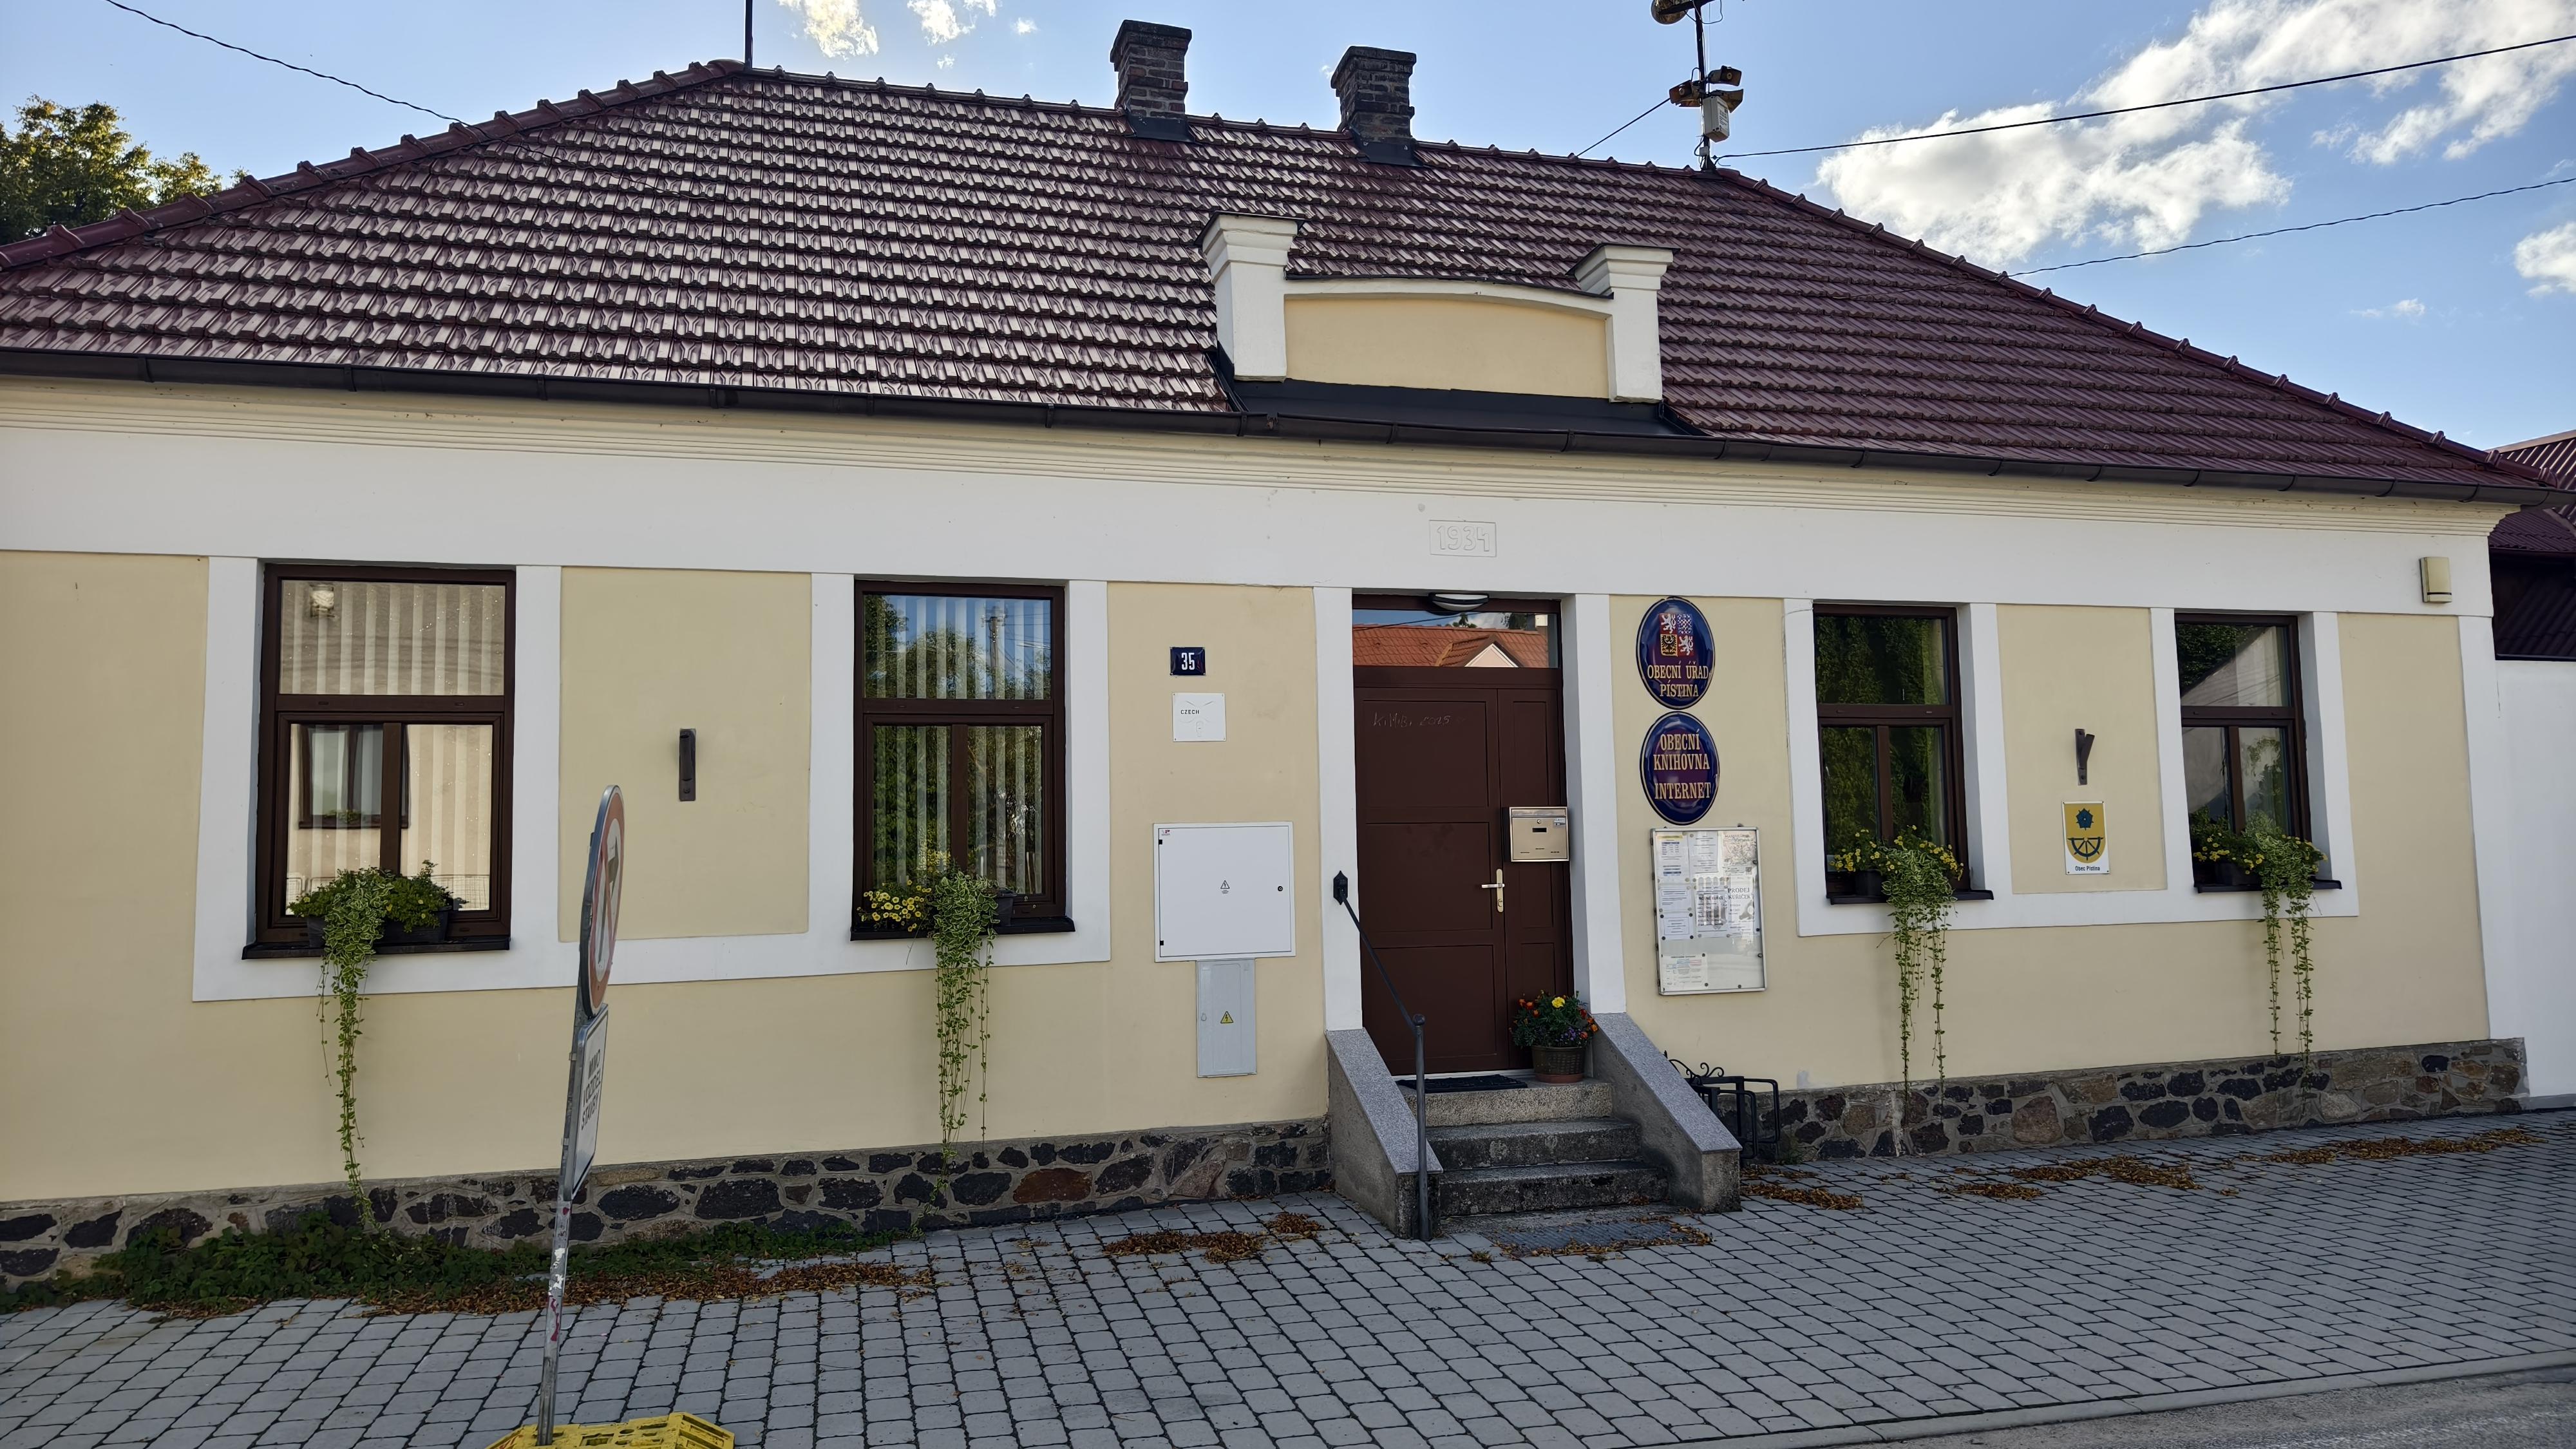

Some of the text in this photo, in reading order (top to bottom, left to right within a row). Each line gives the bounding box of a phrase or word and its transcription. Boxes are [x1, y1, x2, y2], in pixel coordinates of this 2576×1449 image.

[1437, 526, 1490, 552] 1934
[1181, 652, 1195, 670] 35
[1647, 660, 1709, 679] OBECNÍ ÚŘAD
[1660, 679, 1699, 697] PÍSTINA
[1660, 728, 1700, 751] OBECNÍ
[1653, 753, 1710, 770] KNIHOVNA
[1654, 782, 1711, 799] INTERNET
